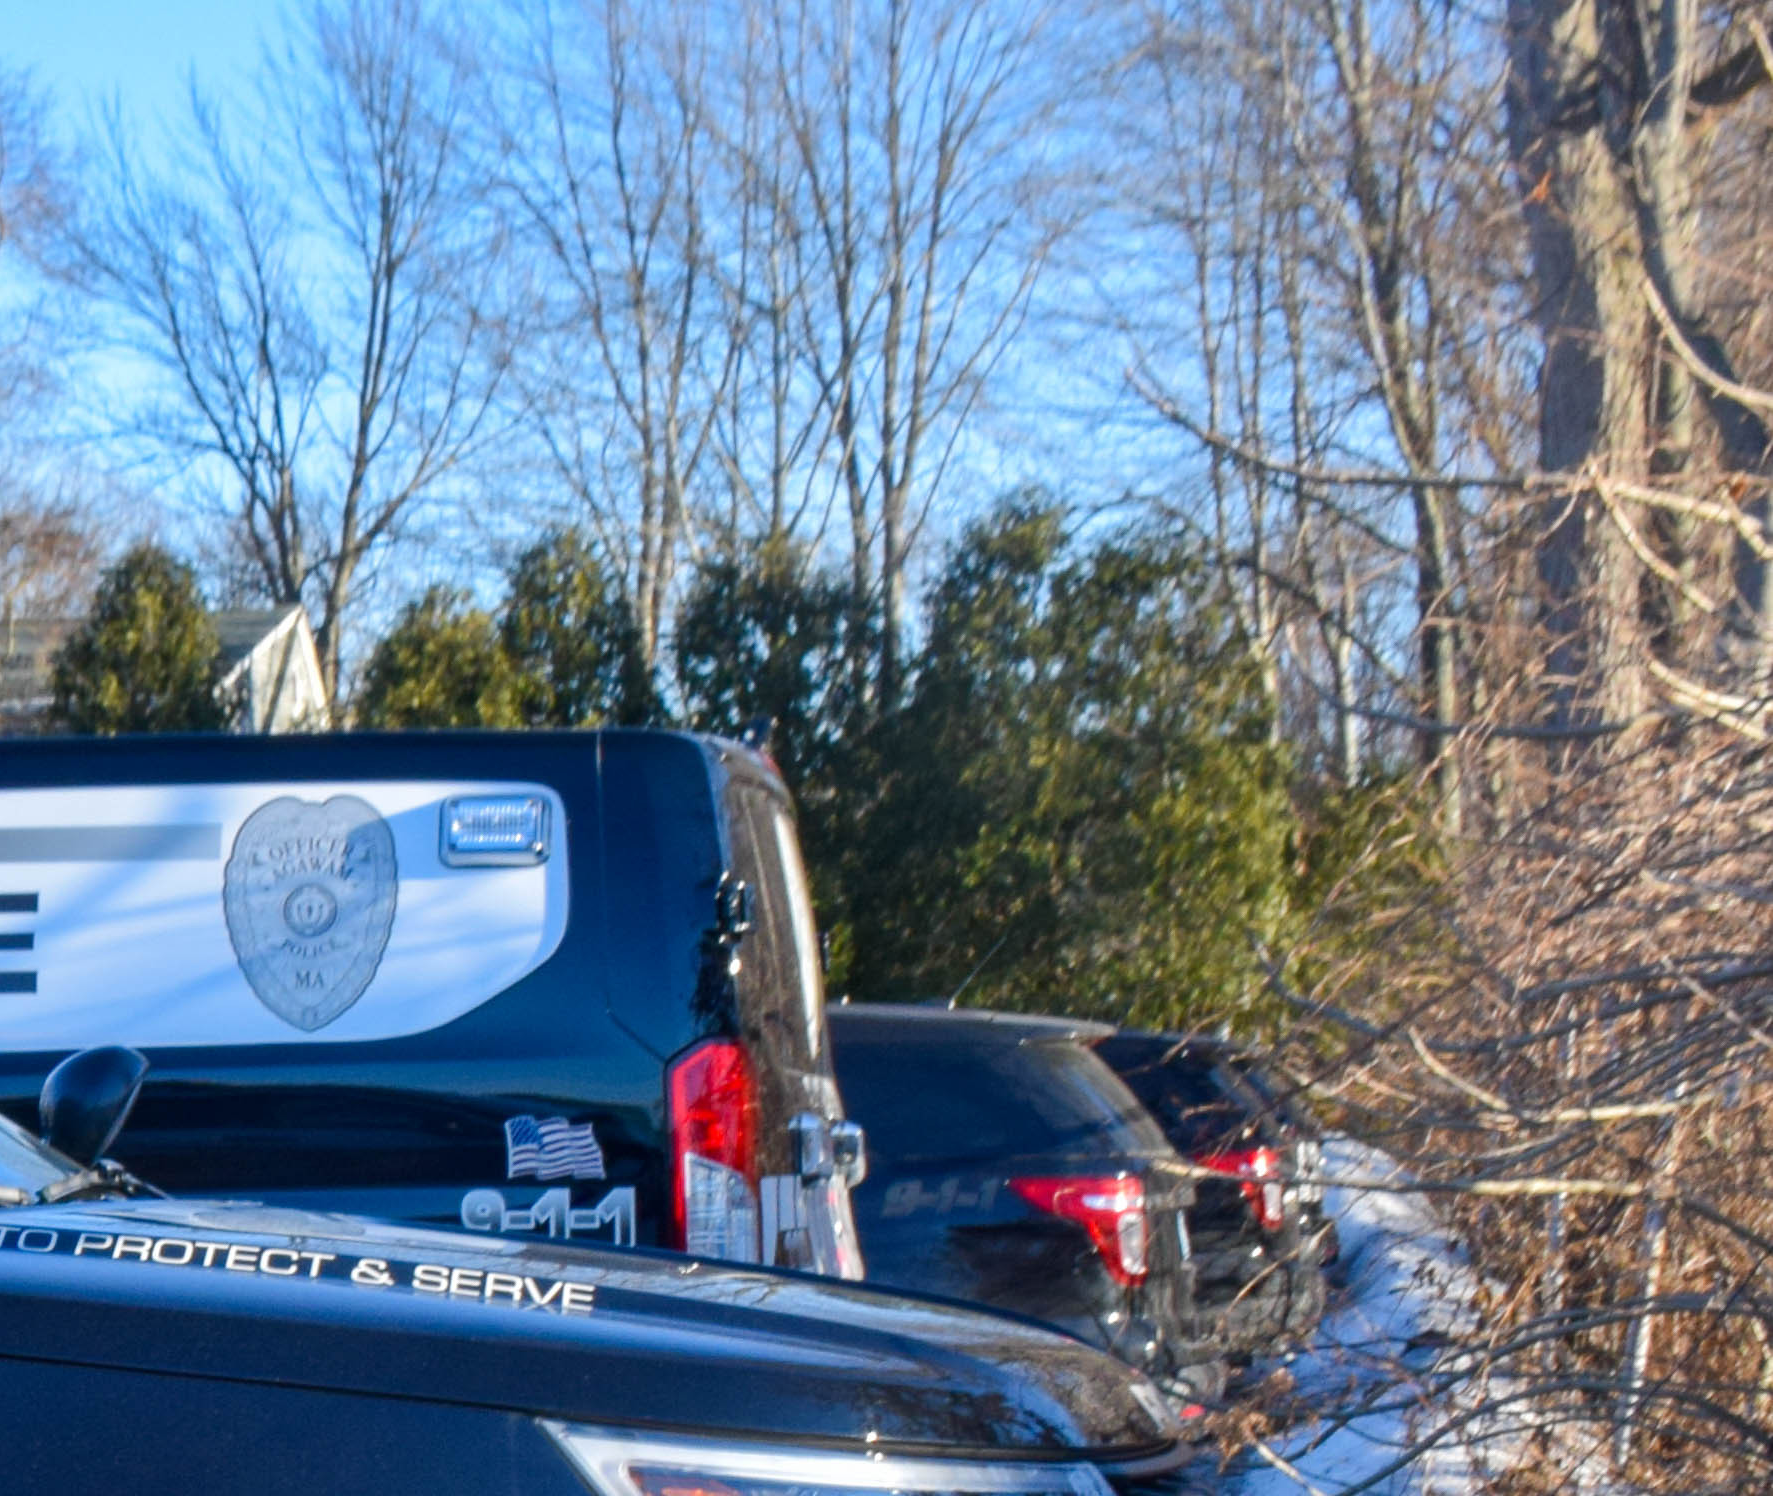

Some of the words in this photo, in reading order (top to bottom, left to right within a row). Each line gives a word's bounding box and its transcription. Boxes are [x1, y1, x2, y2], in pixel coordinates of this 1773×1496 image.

[295, 970, 325, 989] MA
[73, 1232, 335, 1279] PROTECT
[350, 1259, 394, 1287] &
[411, 1264, 595, 1312] SERVE
